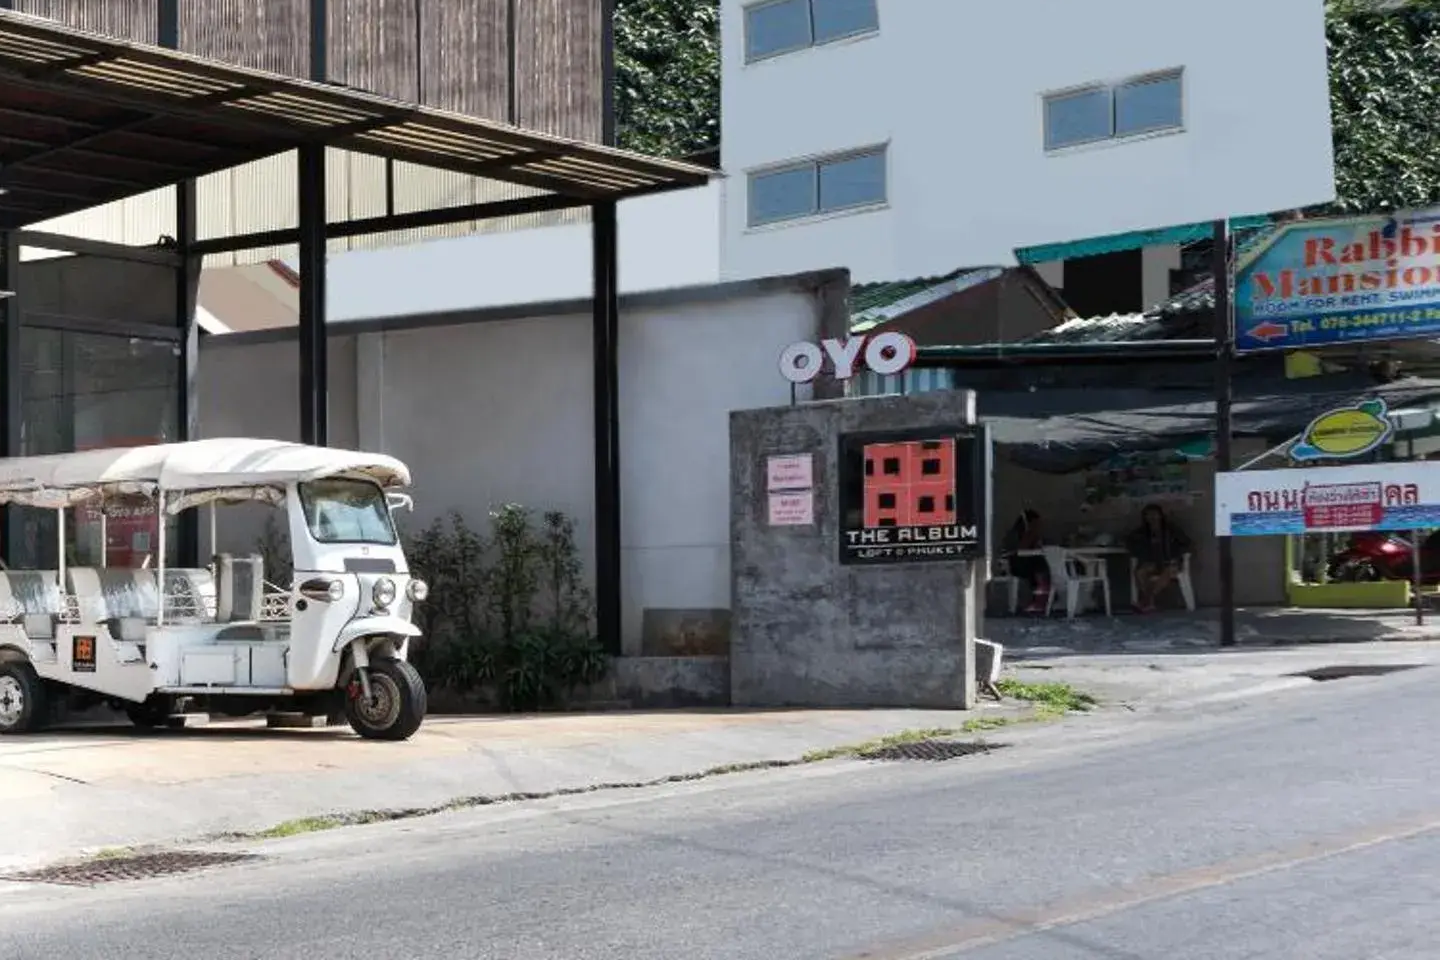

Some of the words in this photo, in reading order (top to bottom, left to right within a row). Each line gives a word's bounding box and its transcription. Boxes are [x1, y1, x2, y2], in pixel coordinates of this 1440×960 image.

[778, 331, 917, 384] OYO
[846, 529, 890, 543] THE
[898, 525, 978, 541] ALBUM
[907, 544, 966, 555] PHUKET
